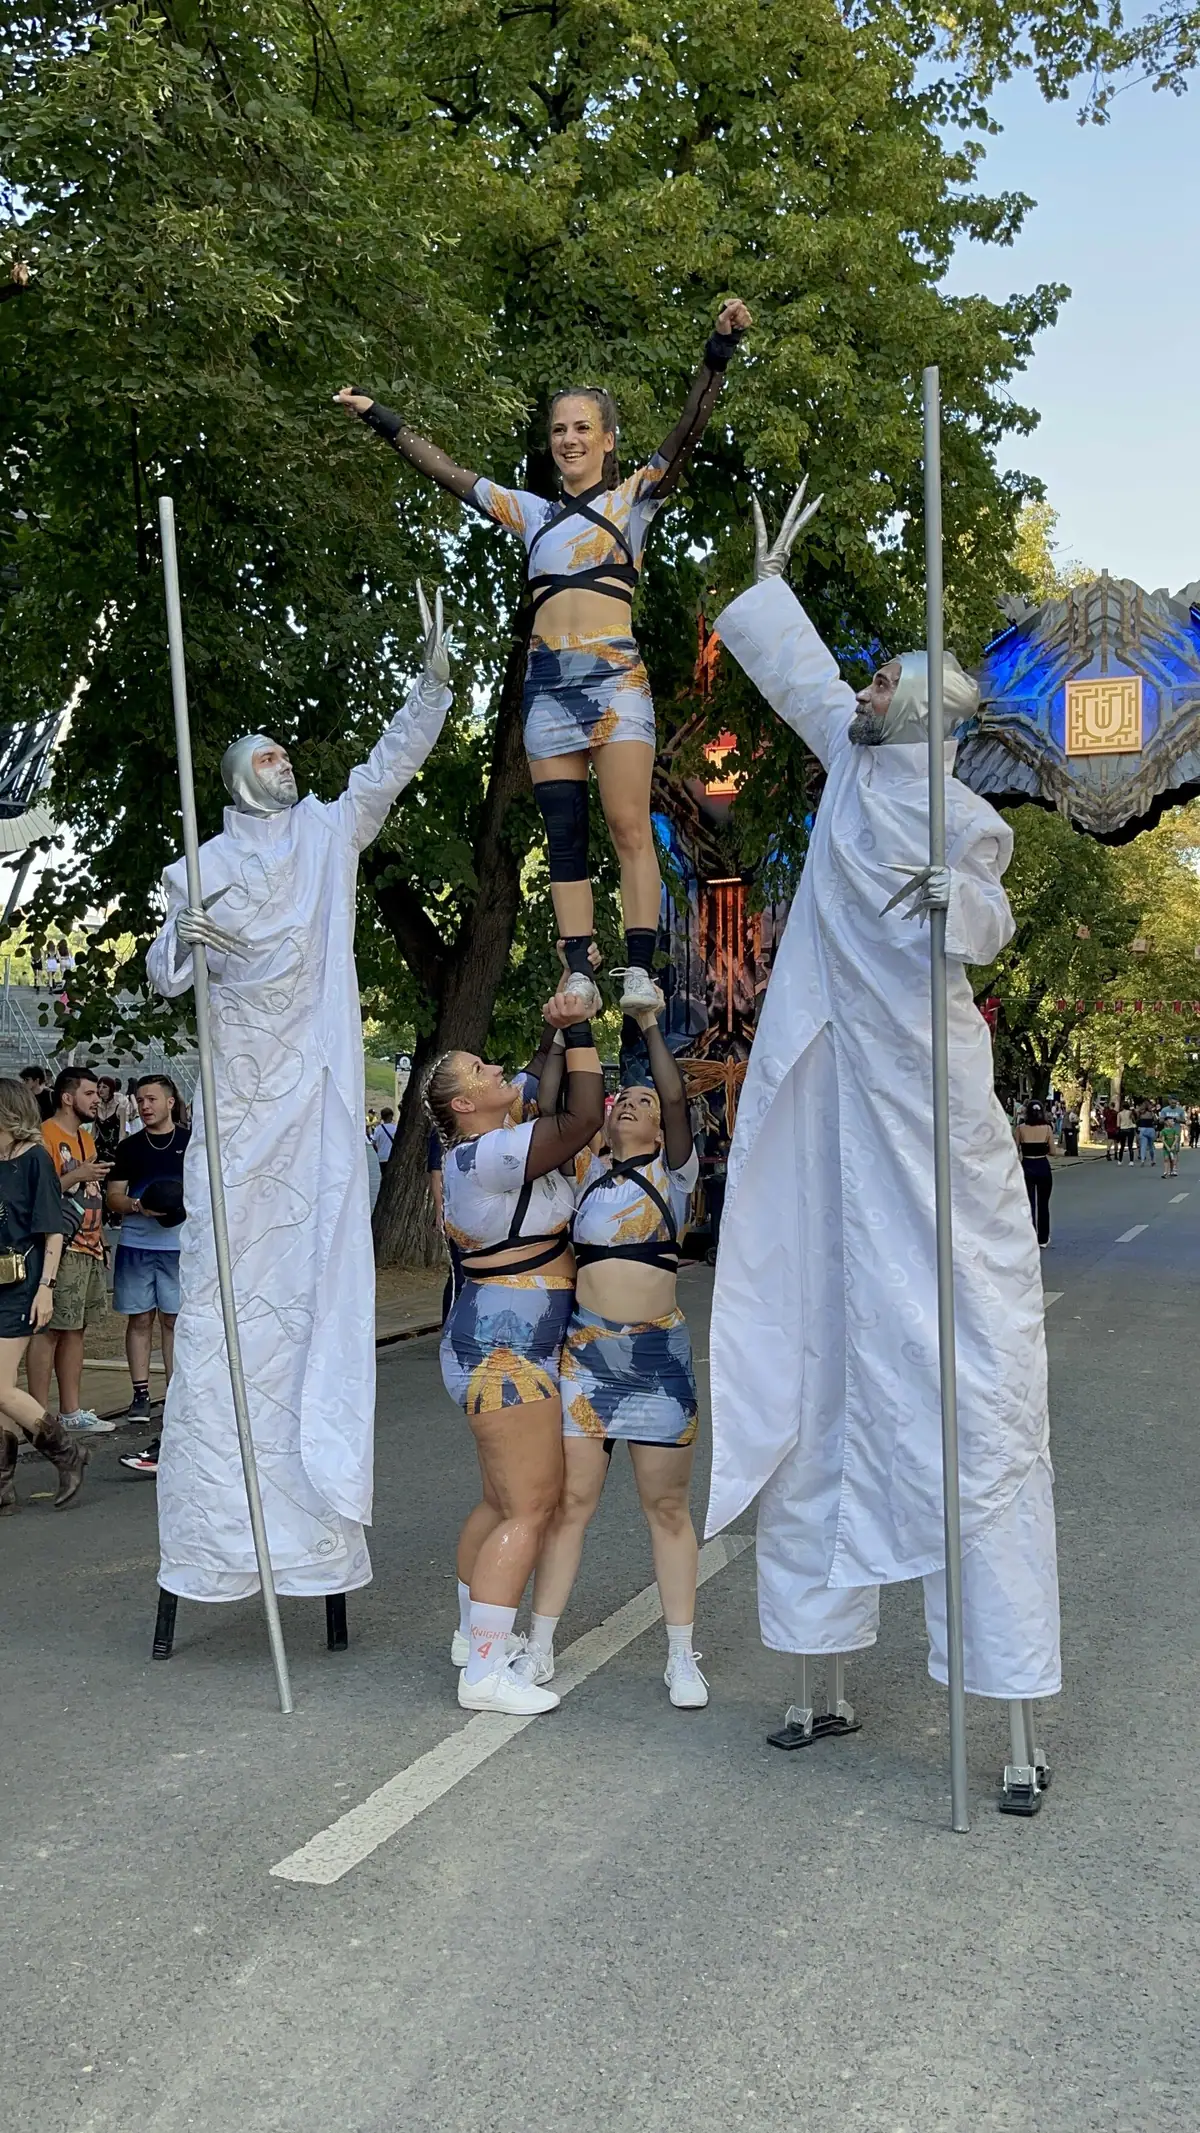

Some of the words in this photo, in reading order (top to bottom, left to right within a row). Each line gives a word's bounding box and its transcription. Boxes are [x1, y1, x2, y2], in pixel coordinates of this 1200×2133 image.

[1085, 695, 1122, 738] U
[470, 1623, 509, 1640] KNIGHTS
[476, 1641, 493, 1660] 4
